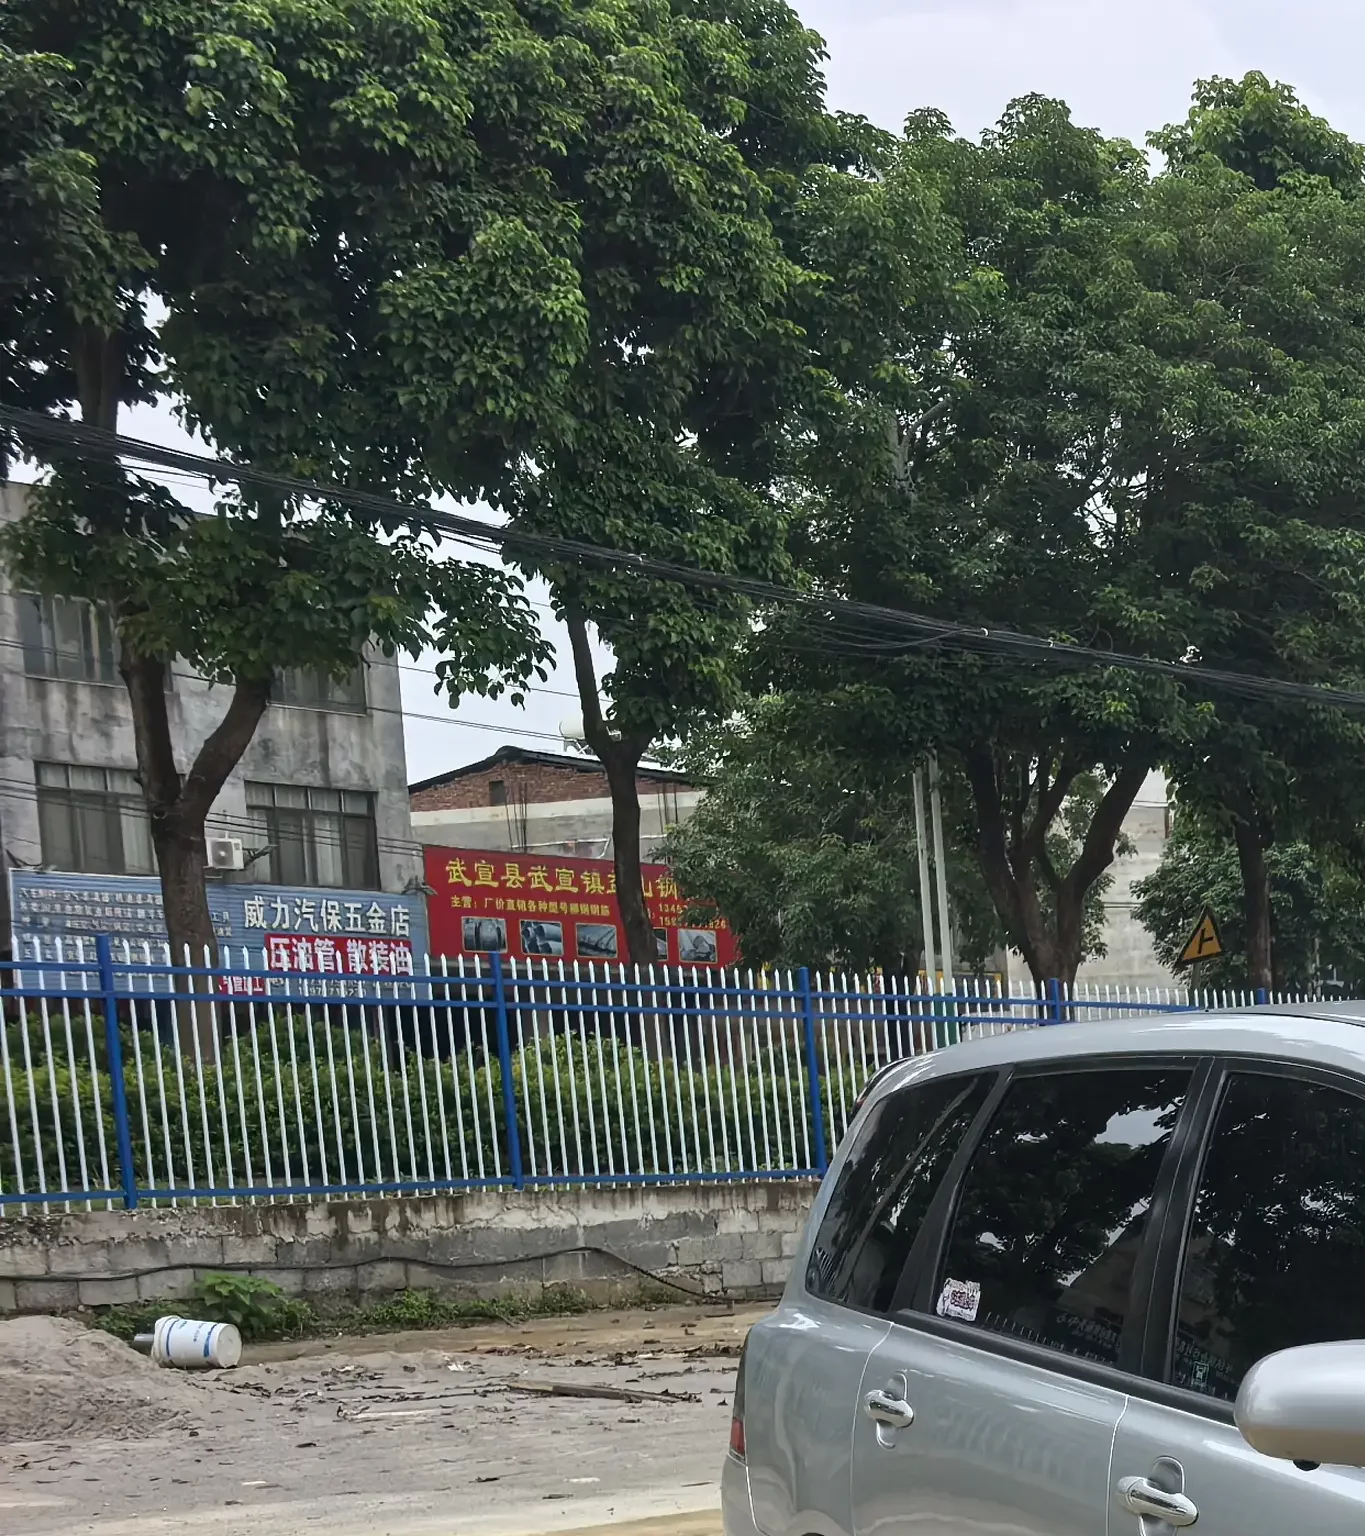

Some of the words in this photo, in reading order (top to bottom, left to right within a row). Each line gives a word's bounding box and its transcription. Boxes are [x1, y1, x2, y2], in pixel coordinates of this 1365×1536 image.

[244, 895, 410, 937] 威力汽保五金店
[346, 938, 411, 974] 散装油
